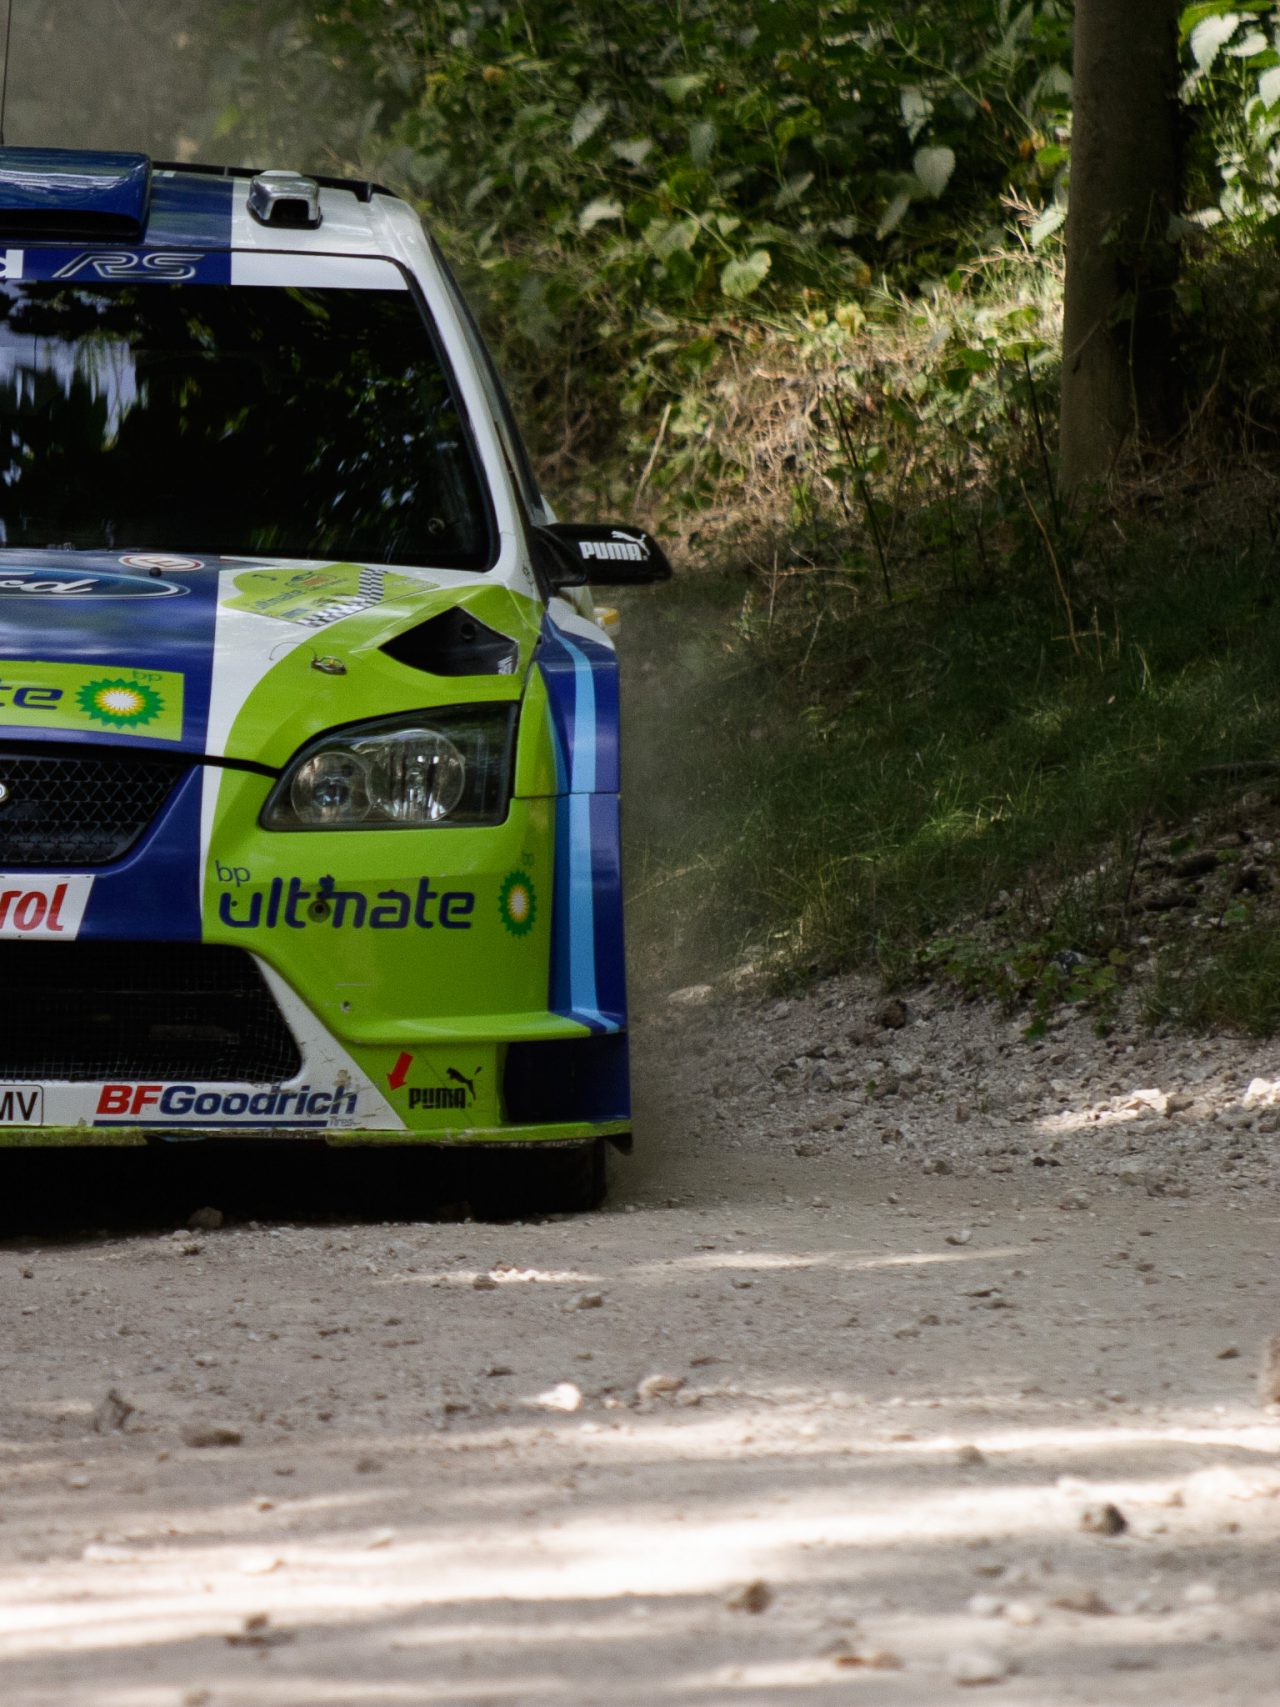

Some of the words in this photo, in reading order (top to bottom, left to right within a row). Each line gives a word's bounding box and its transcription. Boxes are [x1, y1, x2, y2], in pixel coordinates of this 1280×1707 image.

[52, 252, 207, 280] RS
[579, 541, 643, 561] PUMA
[215, 860, 251, 888] bp
[219, 875, 475, 929] ultimate
[96, 1084, 358, 1115] BFGoodrich
[409, 1088, 466, 1109] PUMA
